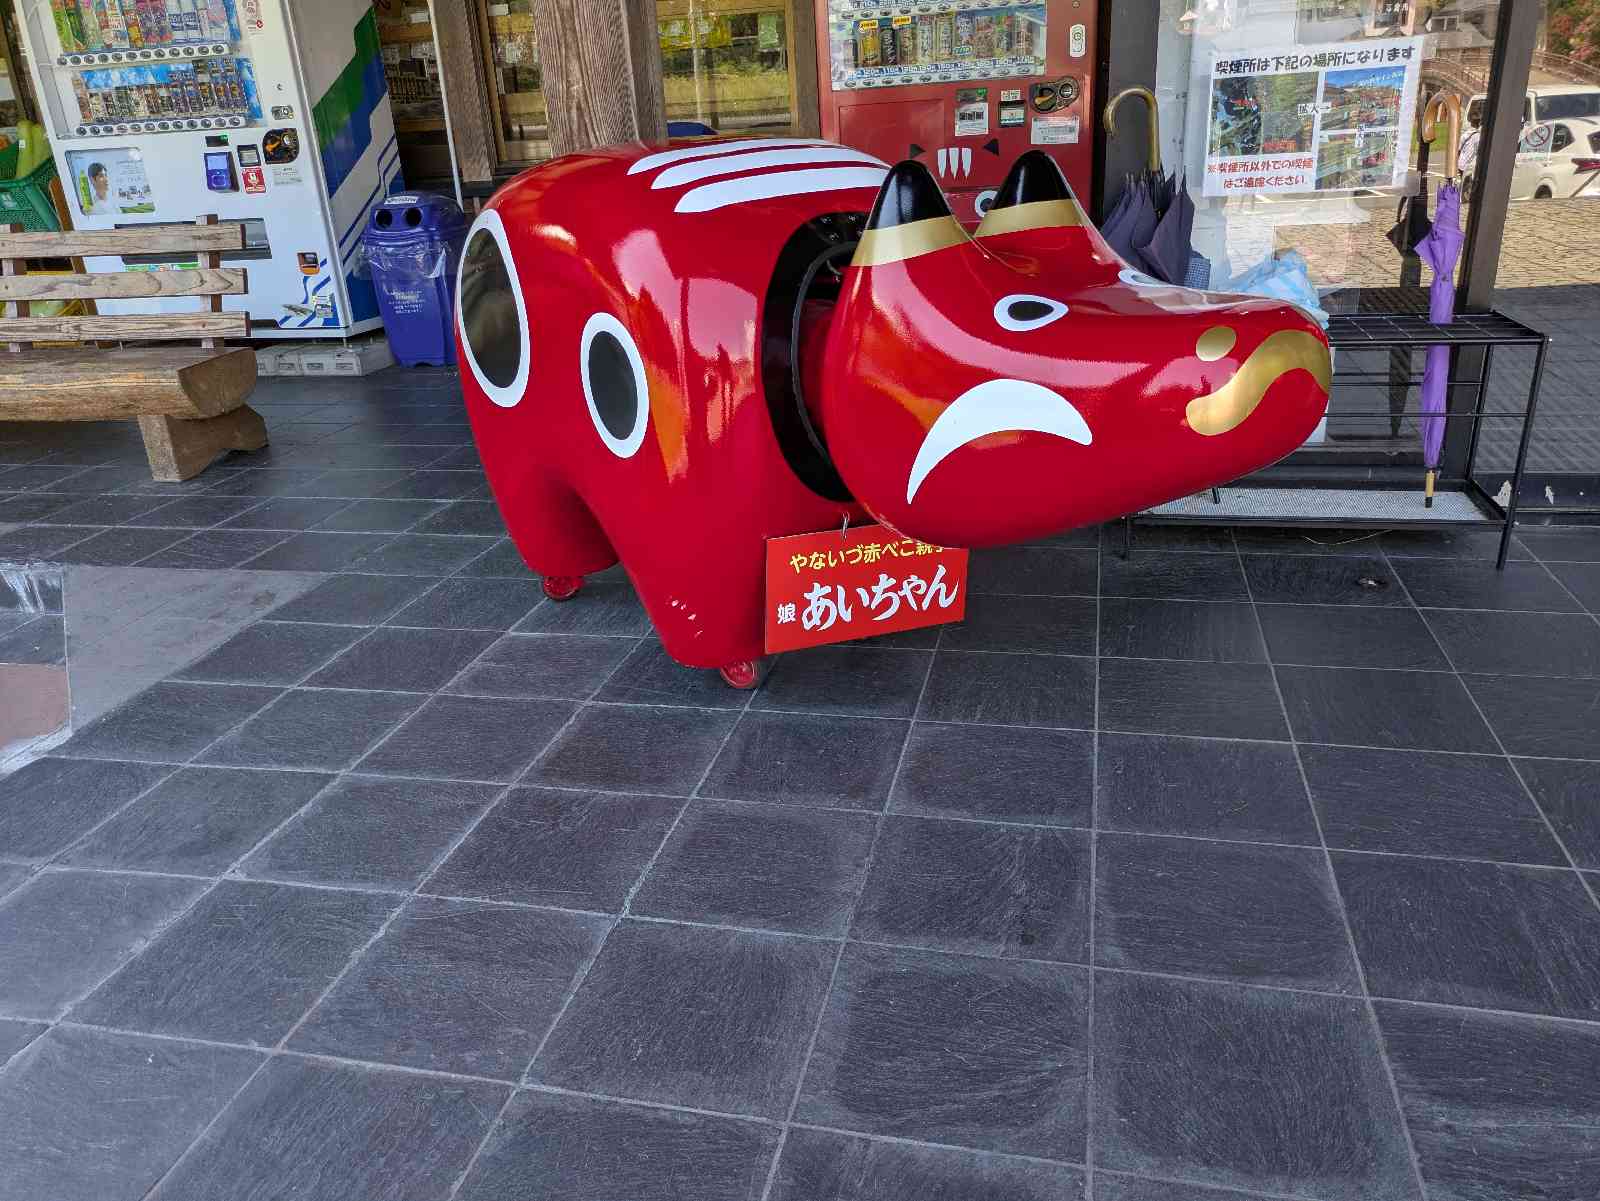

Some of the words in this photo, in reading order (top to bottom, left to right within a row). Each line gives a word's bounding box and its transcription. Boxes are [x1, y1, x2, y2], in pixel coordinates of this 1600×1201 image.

[1215, 45, 1415, 75] 喫煙所は下記の場所になります
[777, 602, 797, 624] 娘
[801, 564, 959, 632] あいちゃん
